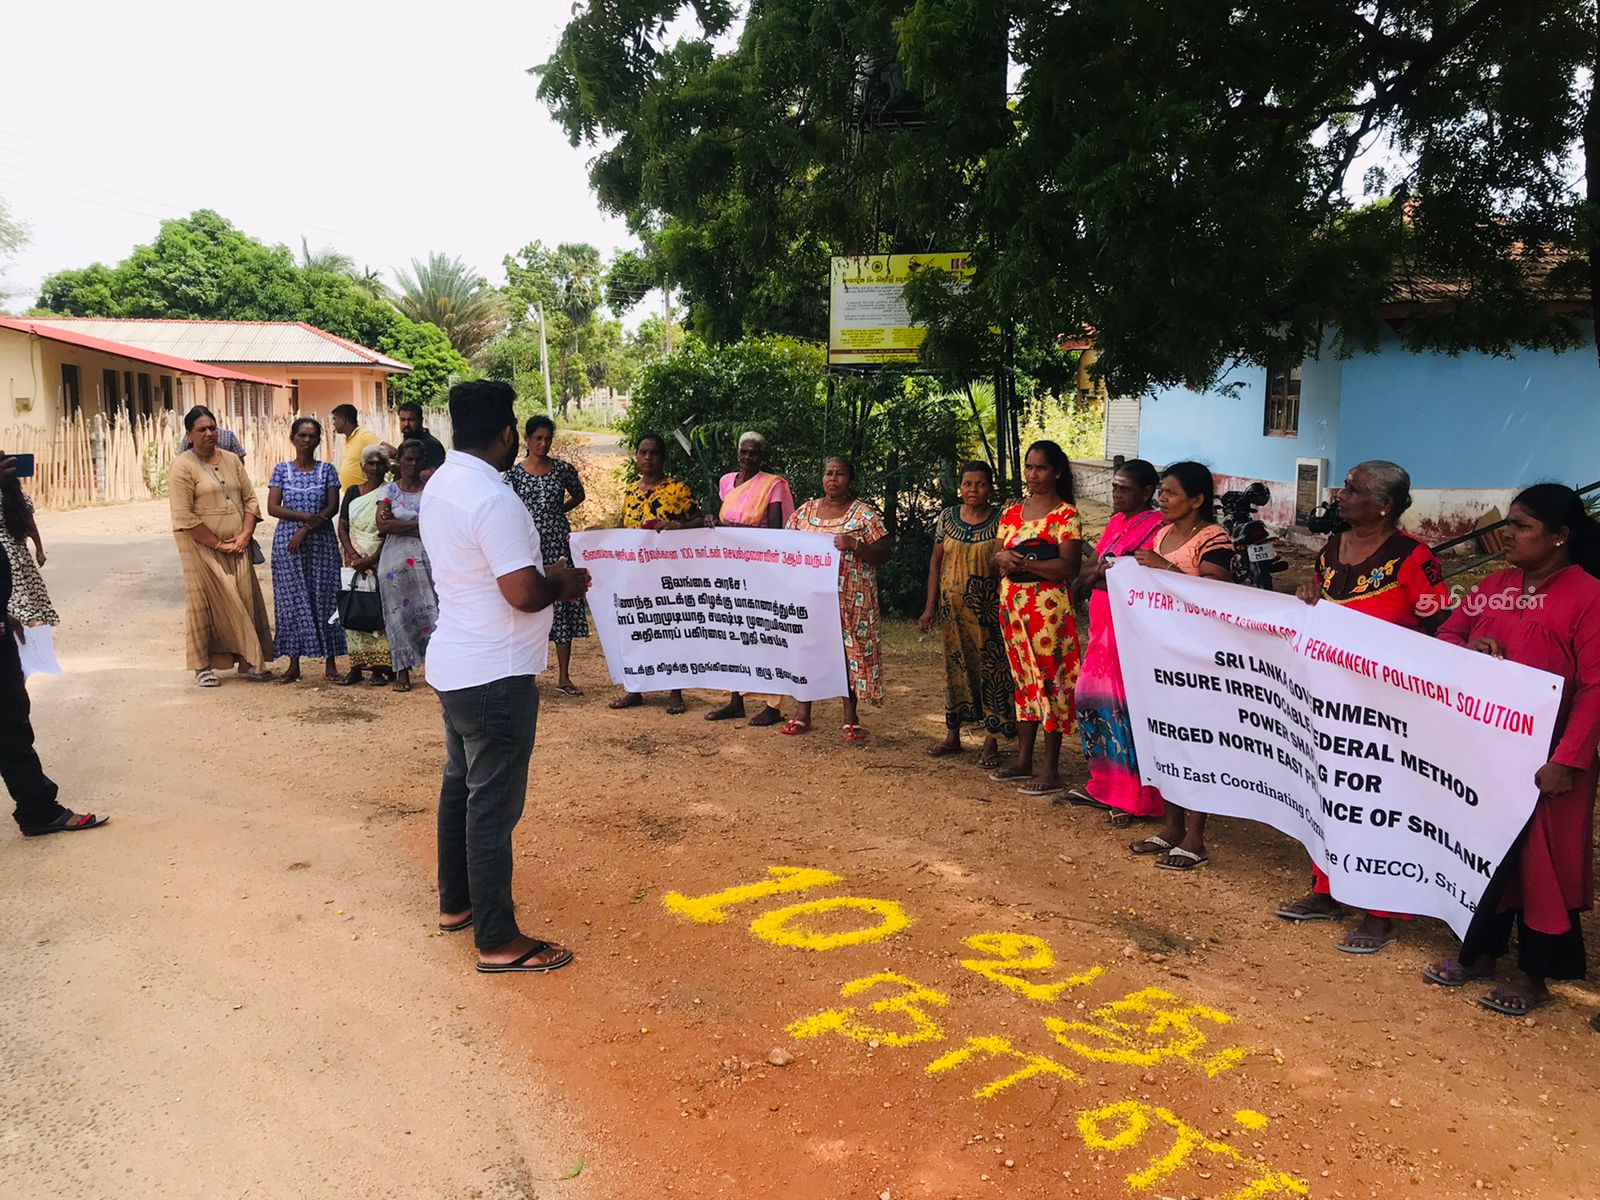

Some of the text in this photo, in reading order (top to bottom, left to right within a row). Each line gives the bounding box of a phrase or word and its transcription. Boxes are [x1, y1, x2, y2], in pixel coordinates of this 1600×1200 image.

[655, 593, 696, 607] வடக்கு
[698, 593, 733, 609] கிழக்கு
[661, 576, 711, 590] இலங்கை
[714, 577, 740, 591] அரசே
[805, 552, 832, 568] வருடம்
[631, 627, 682, 642] அதிகாரப்
[684, 626, 727, 640] பகிர்வை
[728, 631, 758, 645] உறுதி
[637, 612, 706, 626] பெறமுடியாத
[657, 662, 688, 675] கிழக்கு
[1128, 589, 1144, 606] 3rd
[1148, 591, 1174, 611] YEAR
[1304, 637, 1378, 680] PERMANENT
[1383, 666, 1452, 707] POLITICAL
[1456, 692, 1534, 736] SOLUTION
[1214, 651, 1408, 738] SRI LANKA GOVRNMENT!
[1154, 668, 1479, 807] ENSURE IRREVOCABLE EDERAL METHOD
[1238, 708, 1290, 743] POWER
[1334, 769, 1383, 794] FOR
[1147, 718, 1214, 744] MERGED
[1219, 731, 1274, 760] NORTH
[1277, 747, 1304, 778] EAST
[1370, 809, 1402, 828] OF
[1408, 815, 1492, 879] SRILANK
[1153, 756, 1180, 778] orth
[1184, 766, 1217, 784] East
[1220, 772, 1304, 818] Coordinating
[1355, 856, 1429, 884] NECC),
[1435, 872, 1457, 898] Sri
[663, 865, 913, 952] 10
